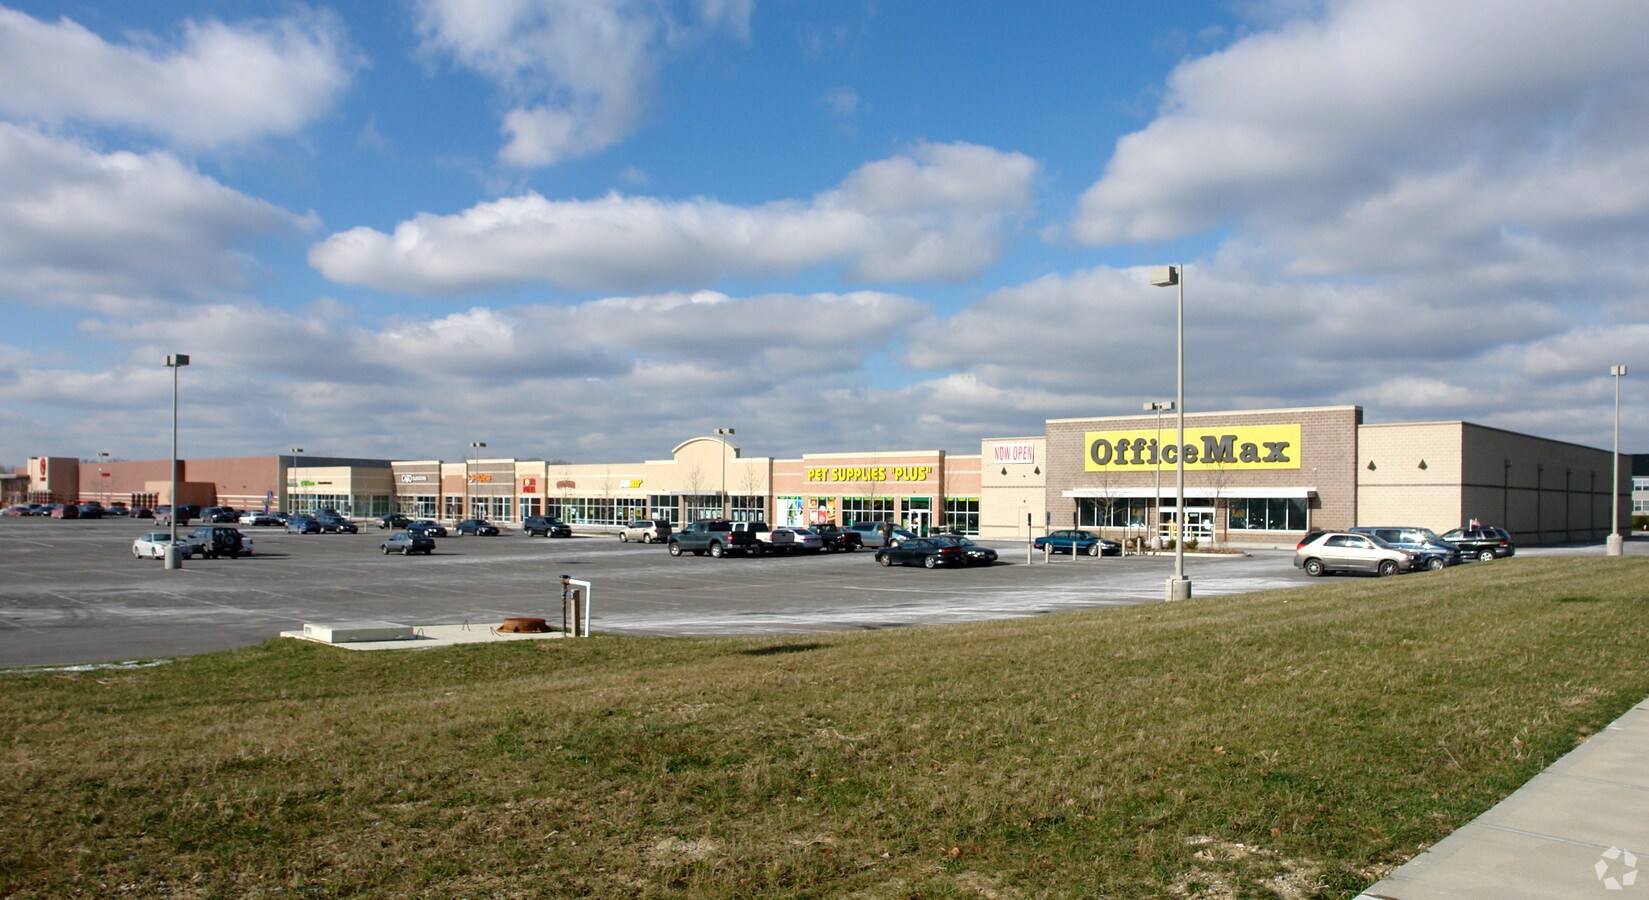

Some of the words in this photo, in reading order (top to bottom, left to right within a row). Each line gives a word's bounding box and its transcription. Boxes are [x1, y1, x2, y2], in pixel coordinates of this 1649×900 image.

[994, 446, 1011, 461] NOW
[1012, 445, 1033, 461] OPEN
[1091, 435, 1290, 465] OfficeMax
[807, 467, 829, 482] PET
[831, 466, 887, 482] SUPPLIES
